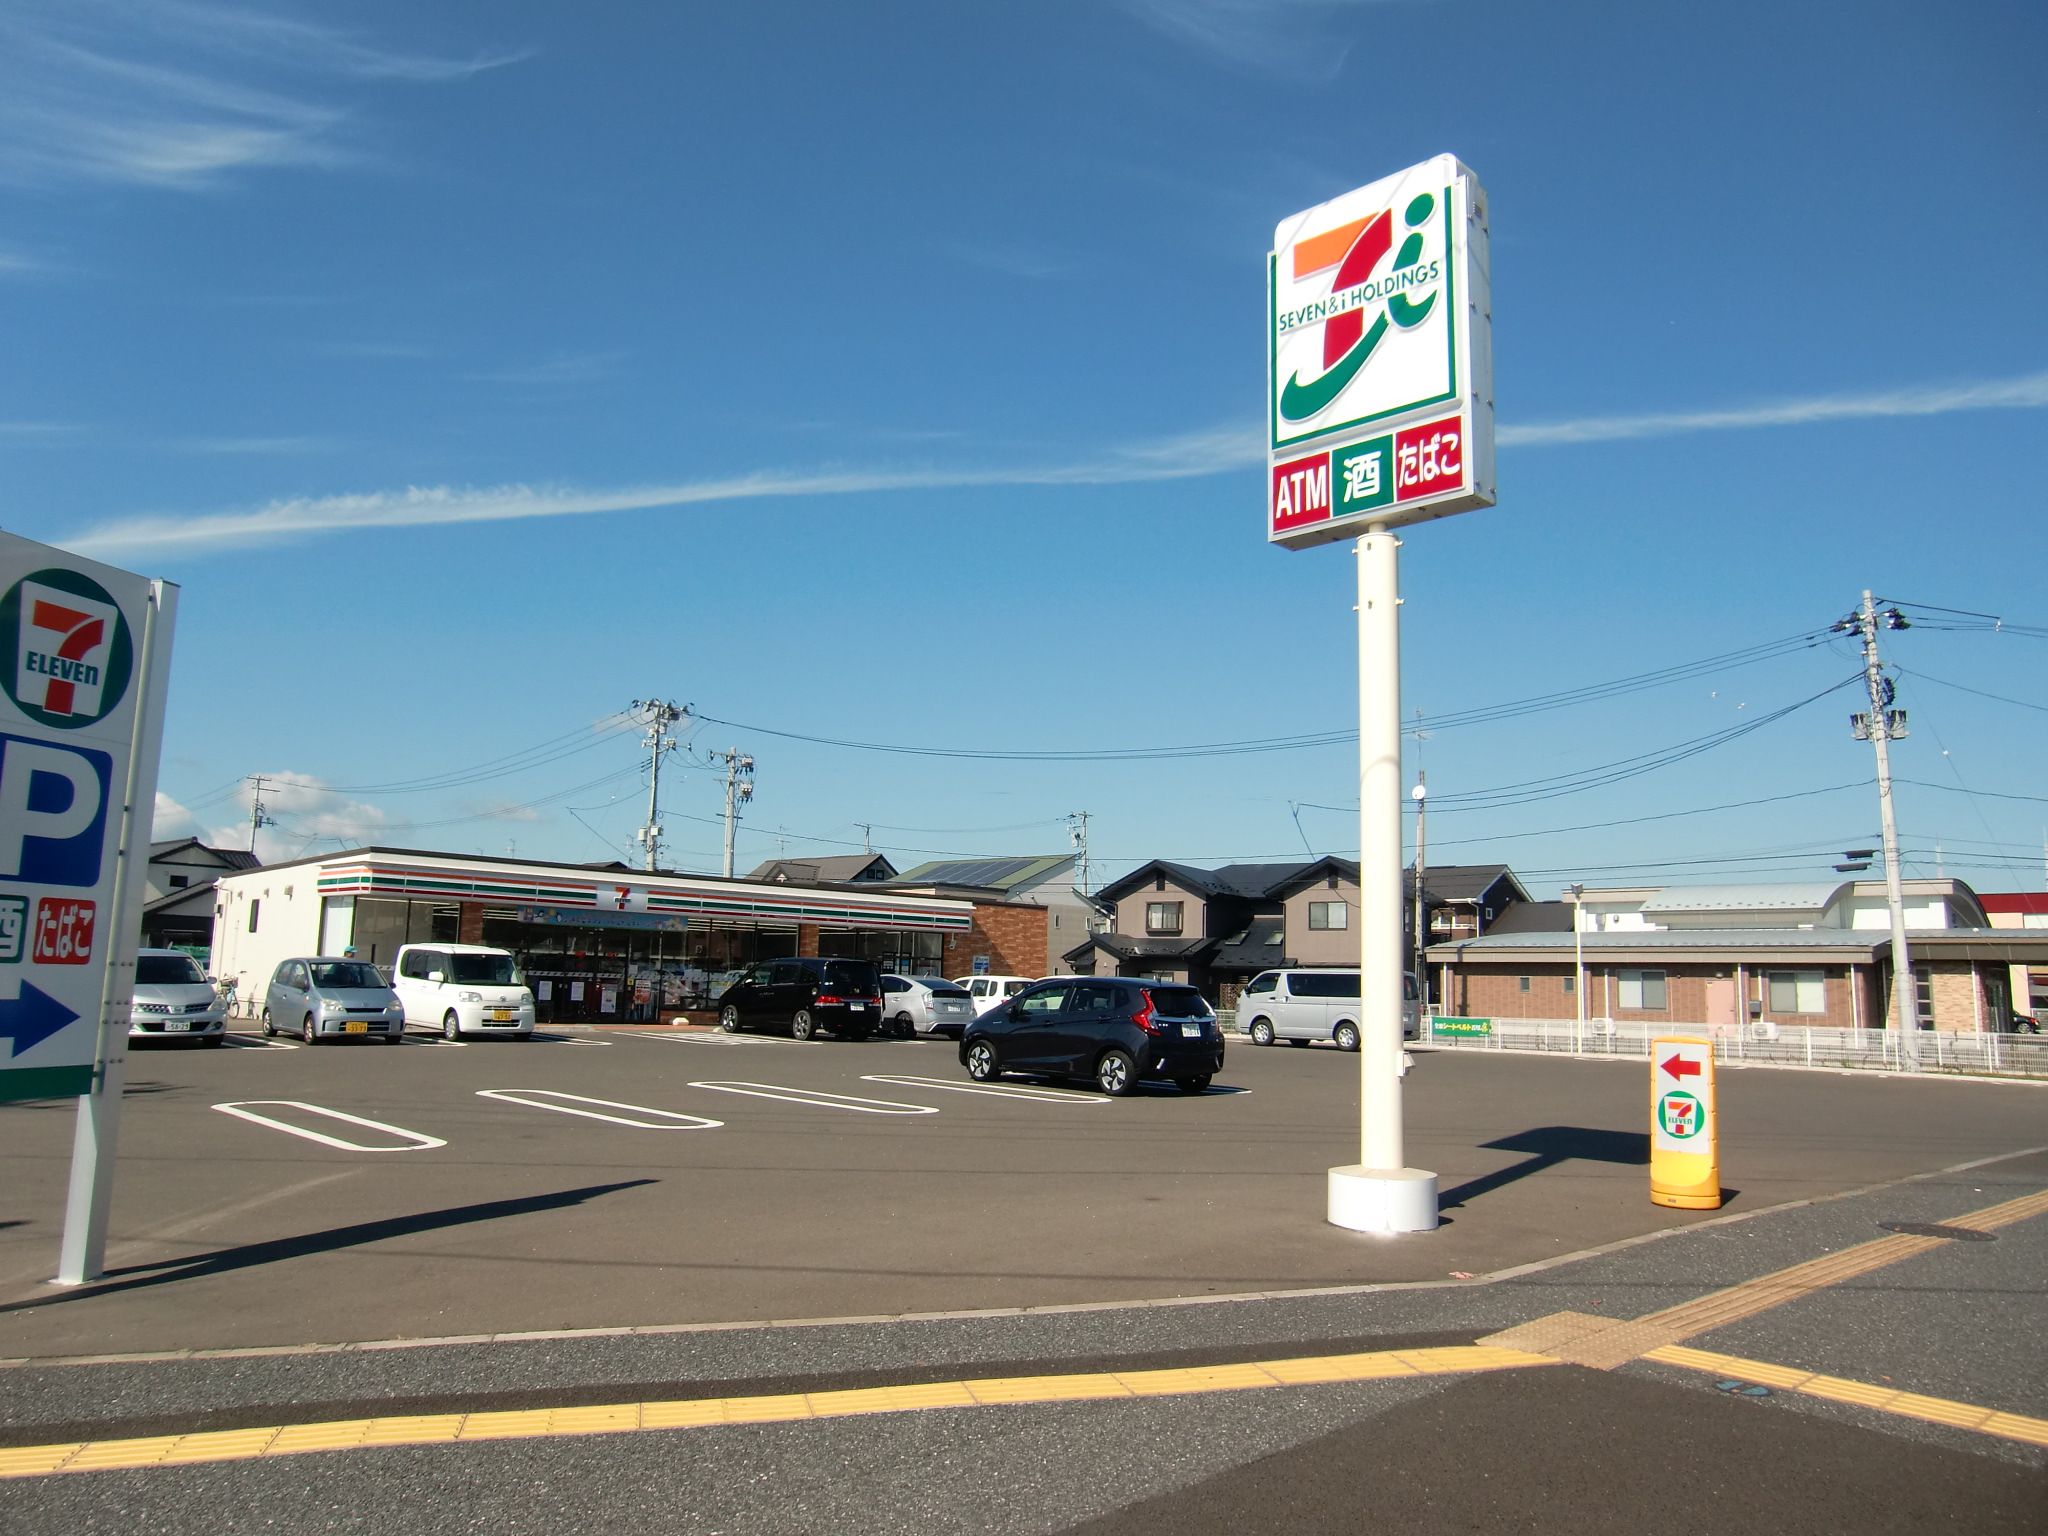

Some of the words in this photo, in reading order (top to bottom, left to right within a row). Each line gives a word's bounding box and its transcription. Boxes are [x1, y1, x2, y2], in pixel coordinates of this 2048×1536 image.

[1351, 260, 1439, 307] HOLDINGS
[1343, 450, 1382, 503] 酒
[1398, 432, 1461, 489] たばこ
[1275, 464, 1327, 519] ATM
[31, 600, 105, 715] 7
[0, 740, 101, 876] P
[35, 903, 94, 959] たばこ
[1668, 1101, 1692, 1134] 7
